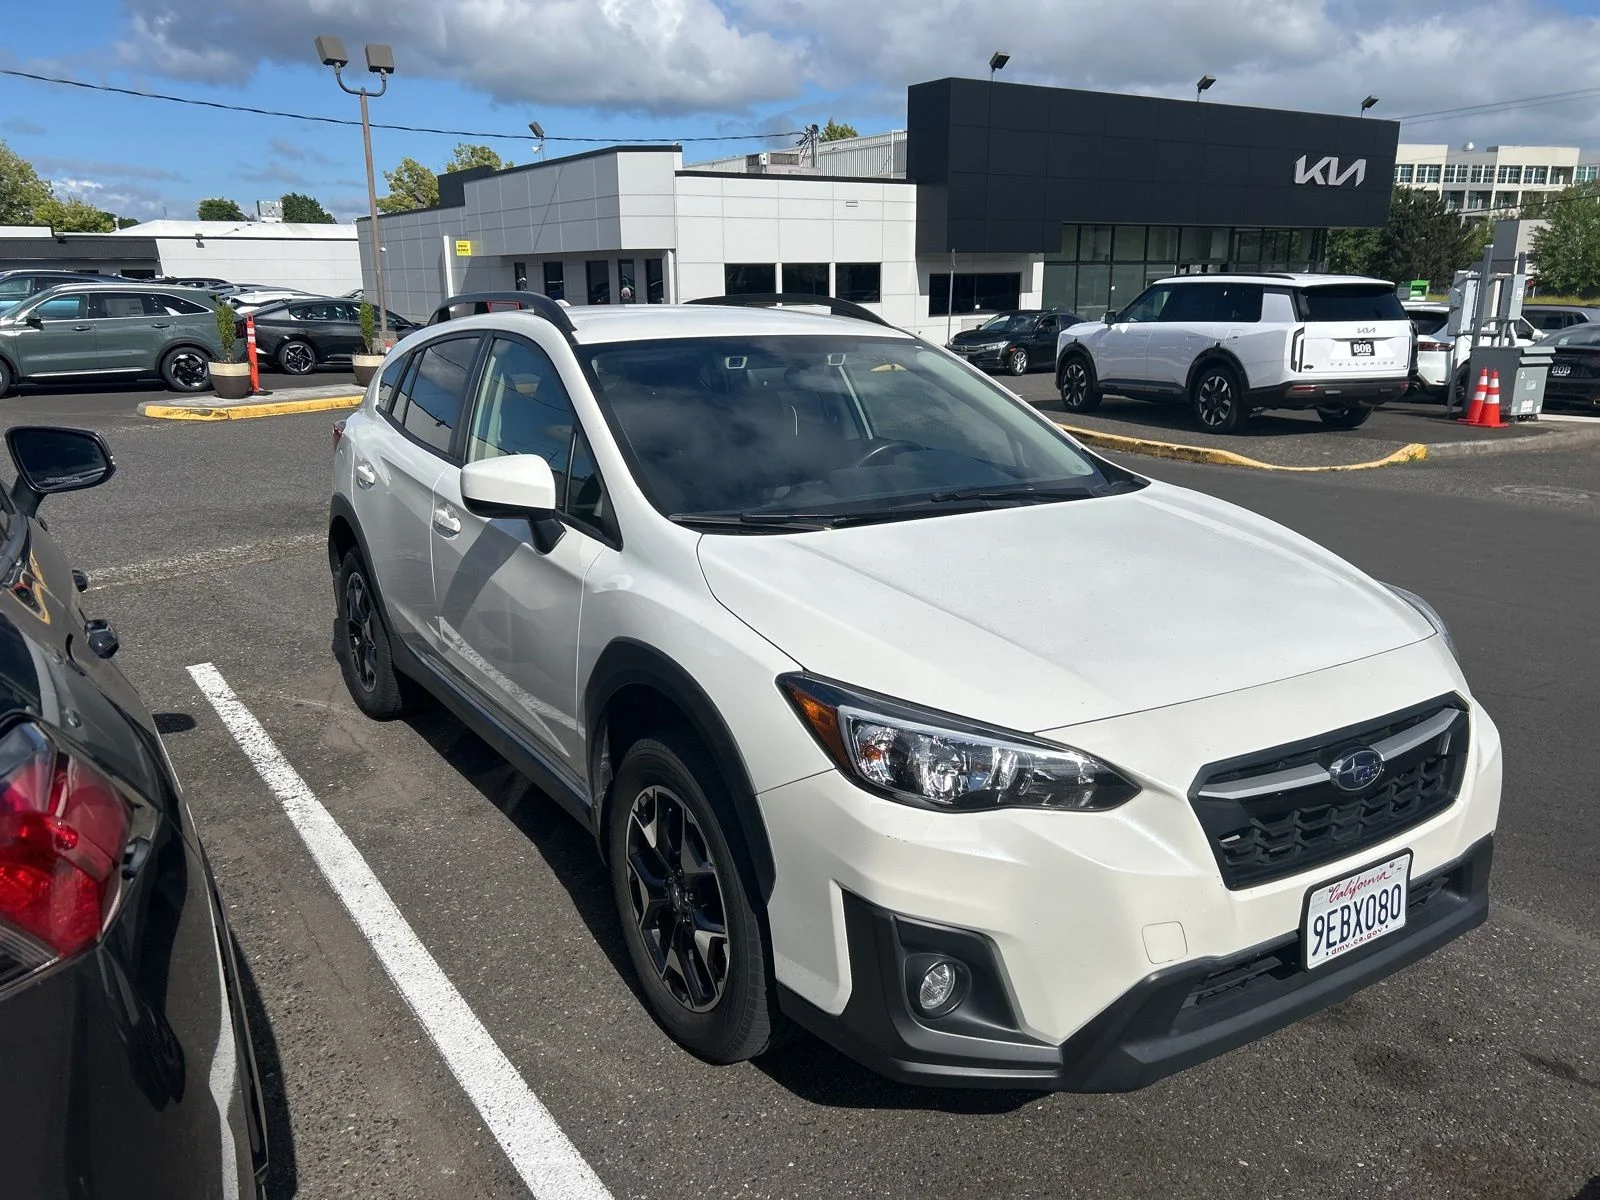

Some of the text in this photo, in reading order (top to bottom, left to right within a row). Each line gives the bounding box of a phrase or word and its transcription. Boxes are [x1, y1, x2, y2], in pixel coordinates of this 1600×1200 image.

[1295, 155, 1367, 186] KIA
[1353, 343, 1372, 353] BOB
[1551, 366, 1571, 374] BOB
[1329, 868, 1392, 903] California
[1311, 883, 1402, 956] 9EBX080
[1331, 928, 1383, 956] dmv.ca.gov
